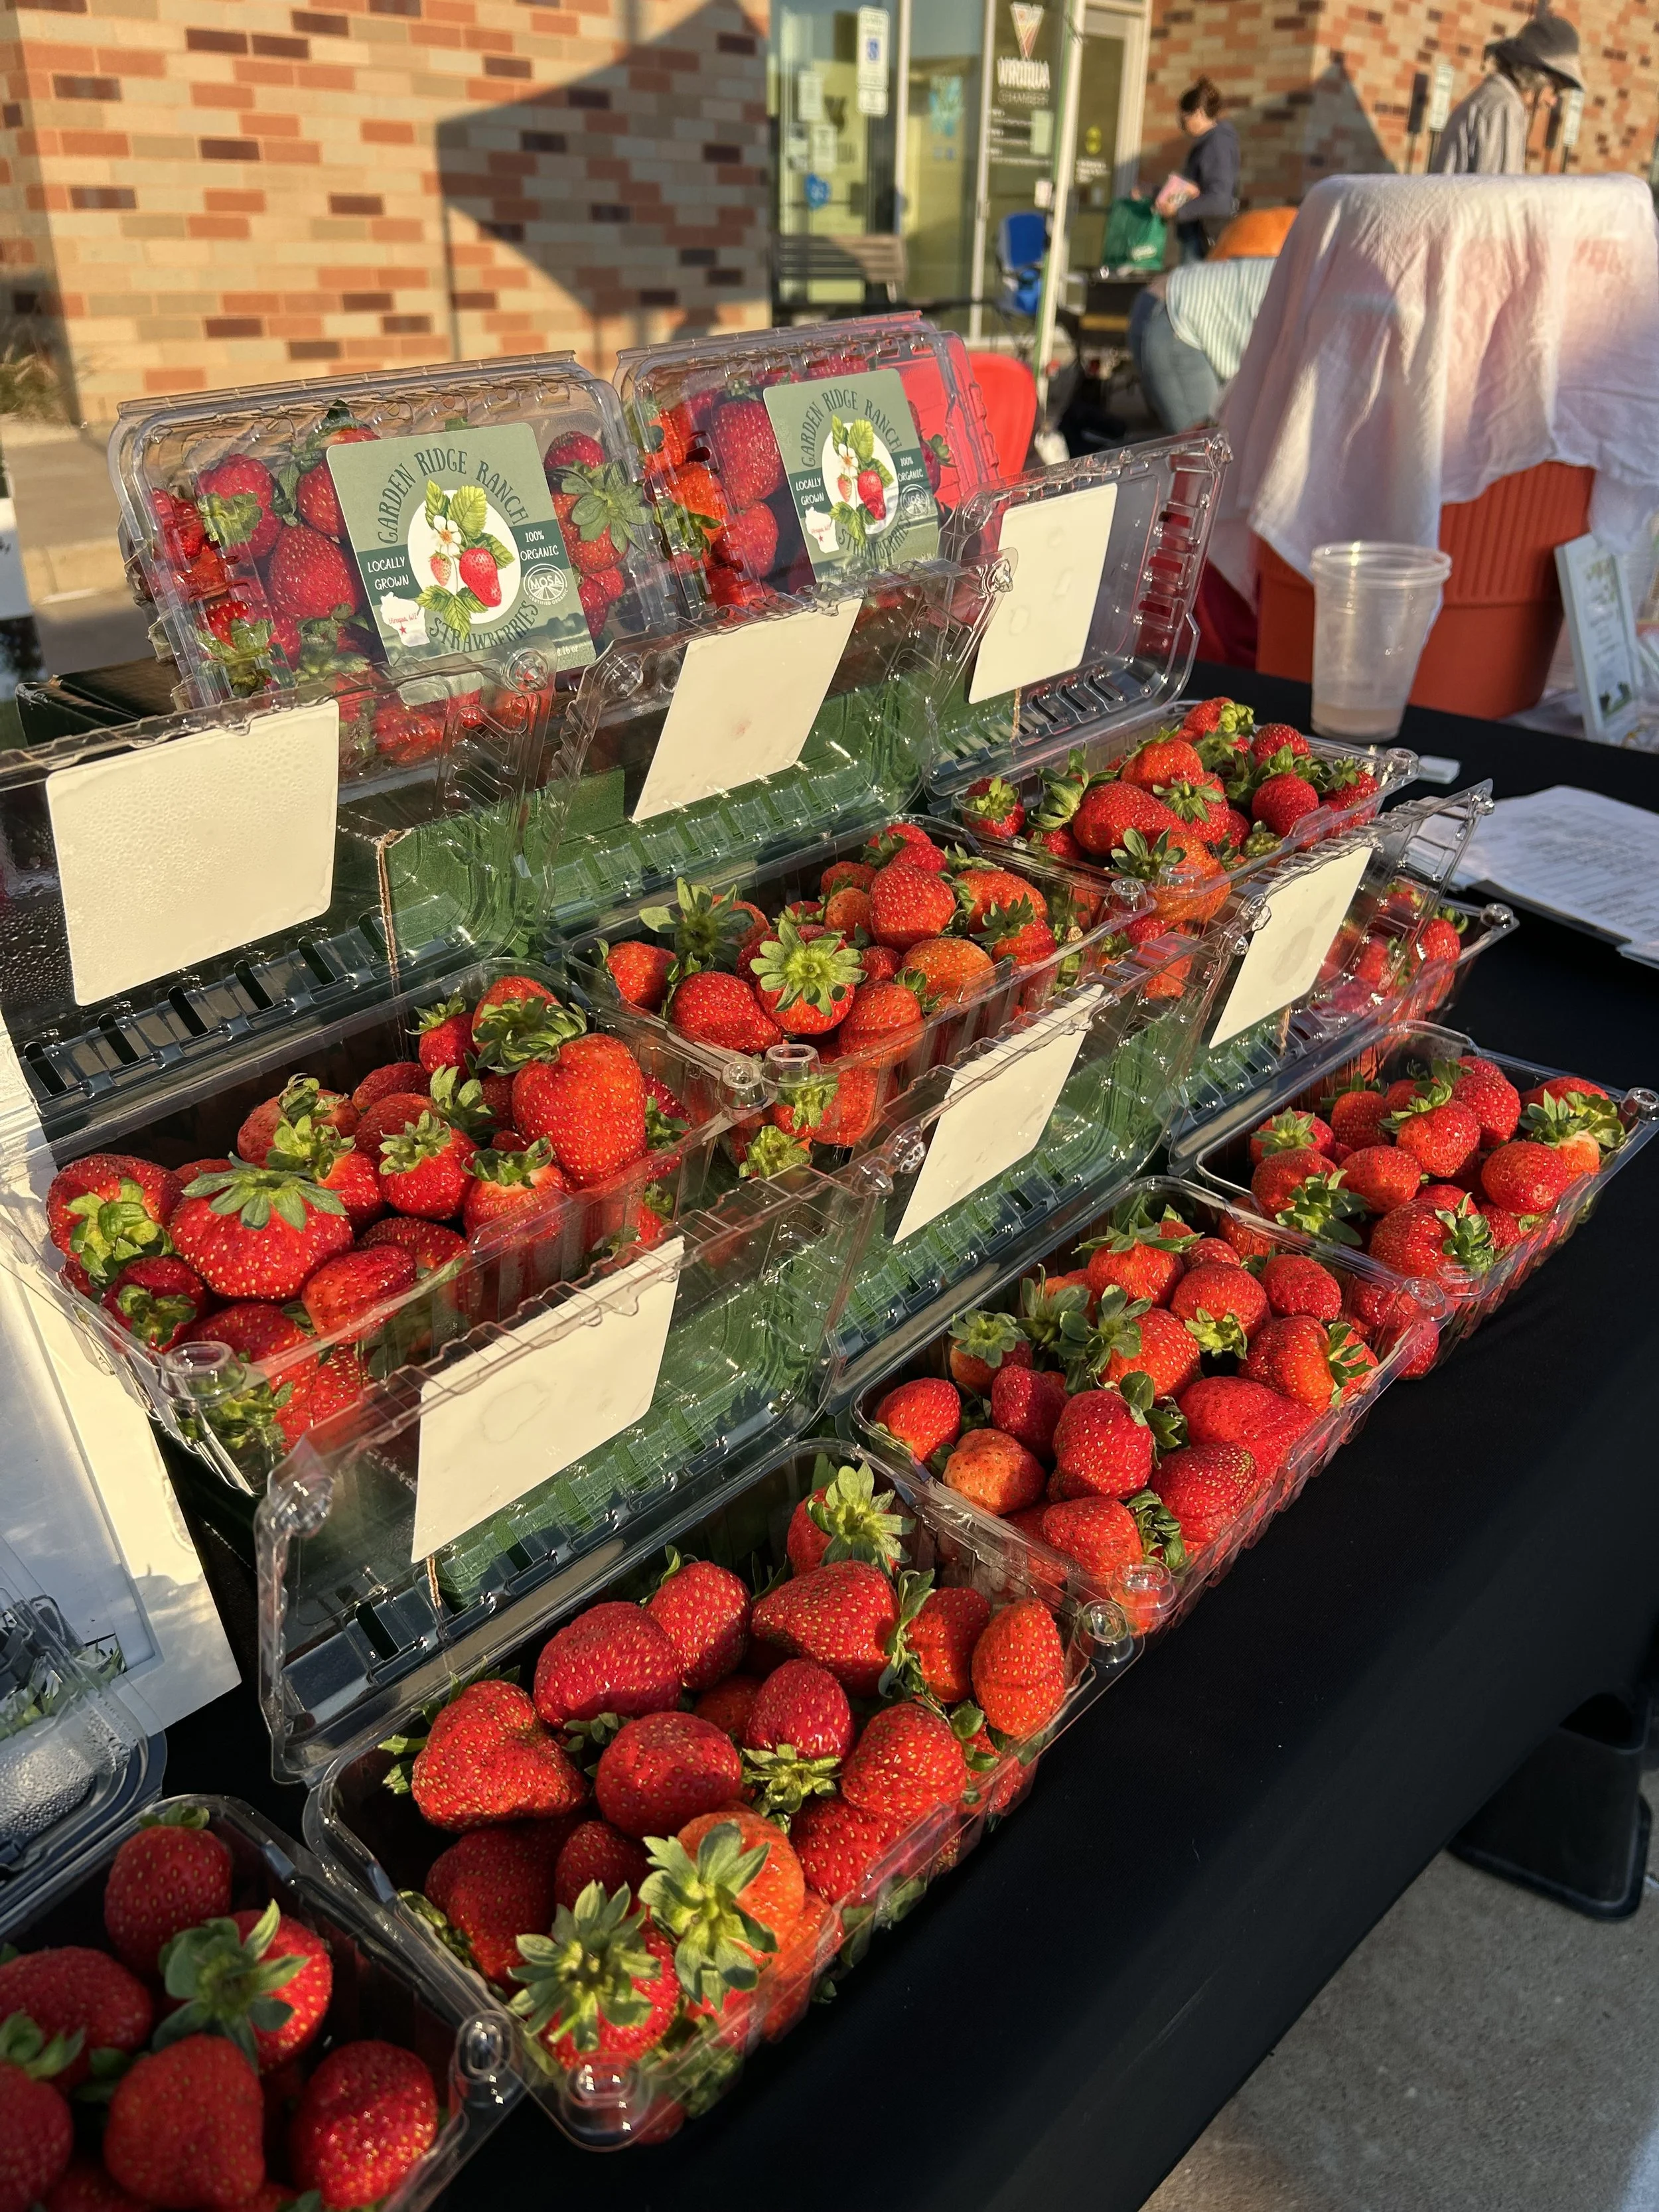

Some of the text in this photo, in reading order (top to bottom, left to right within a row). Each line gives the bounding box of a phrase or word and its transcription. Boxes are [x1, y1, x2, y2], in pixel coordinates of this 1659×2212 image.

[801, 388, 902, 467] GARDEN RIDGE RANCH
[900, 456, 913, 467] 100%
[897, 469, 924, 482] ORGANIC
[796, 477, 822, 491] LOCALLY
[377, 448, 529, 544] GARDEN RIDGE RANCH
[800, 492, 825, 506] GROWN
[525, 530, 545, 543] 100%
[520, 545, 559, 561] ORGANIC
[367, 556, 405, 573] LOCALLY
[374, 574, 409, 591] GROWN
[530, 574, 563, 590] MOSA
[551, 589, 569, 605] ORGANIC
[429, 600, 539, 652] STRAWBERRIES
